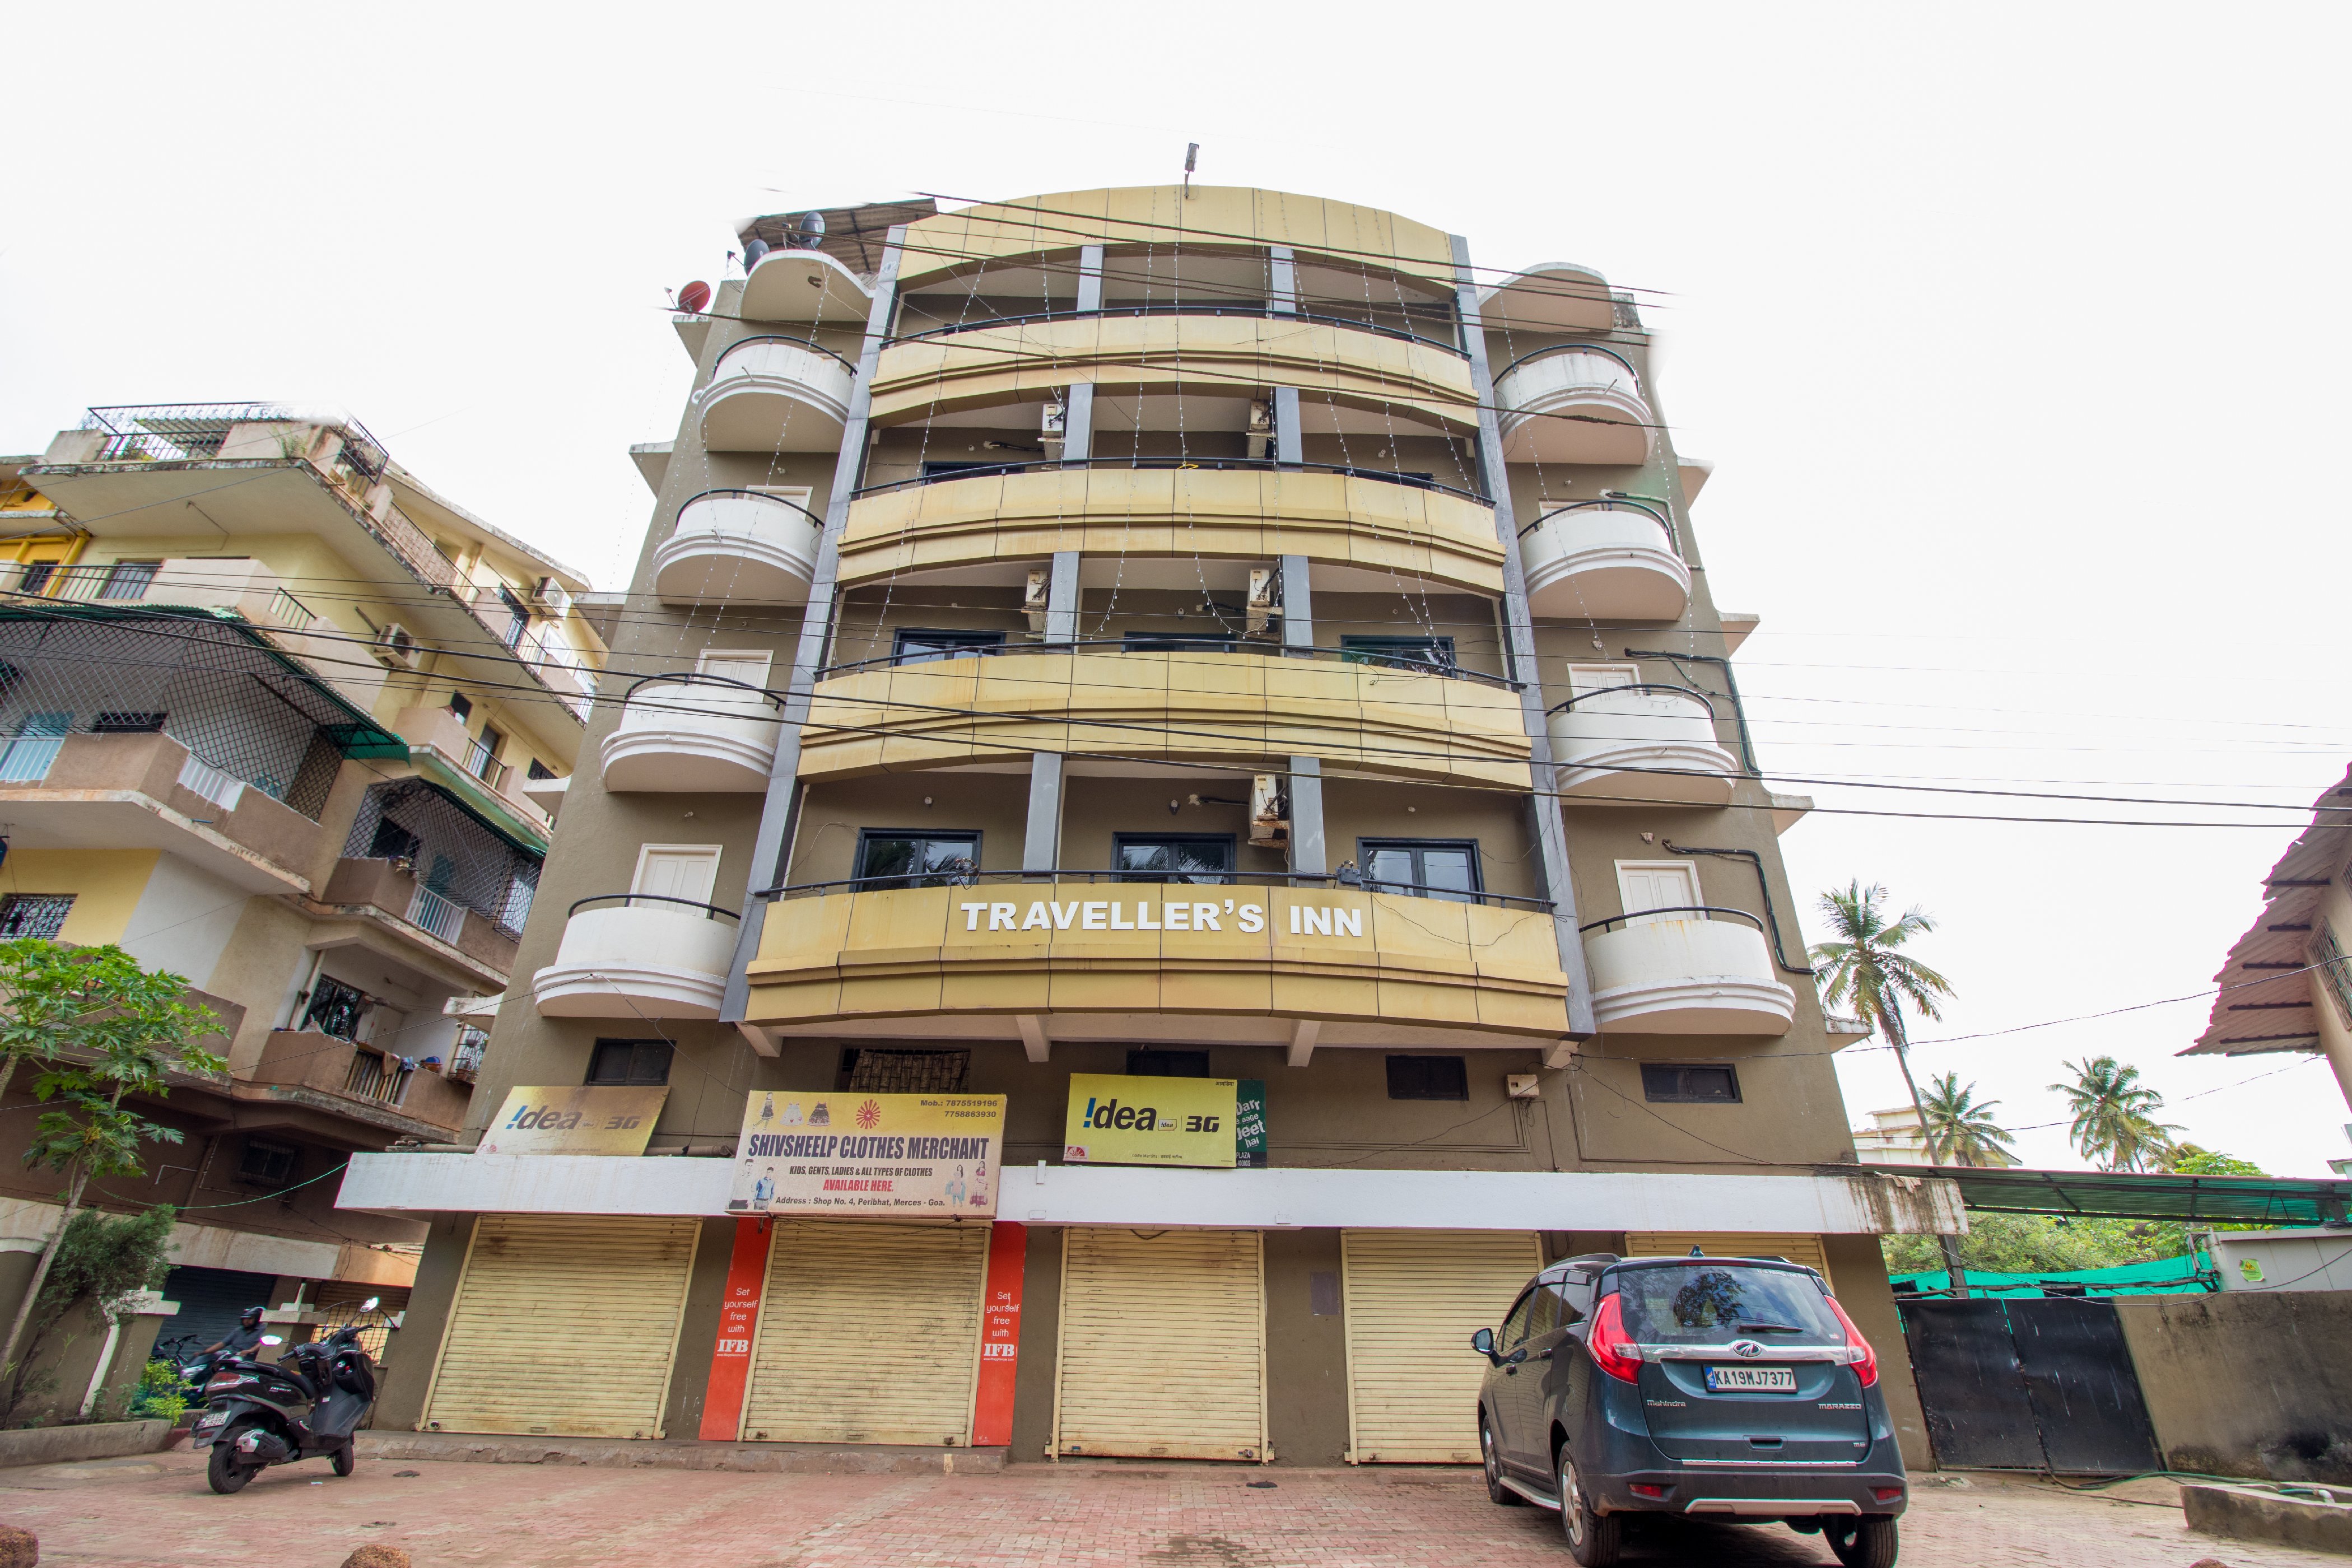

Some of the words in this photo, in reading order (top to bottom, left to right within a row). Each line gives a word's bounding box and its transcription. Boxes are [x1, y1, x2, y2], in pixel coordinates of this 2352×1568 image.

[961, 899, 1264, 934] TRAVELLER'S
[1289, 906, 1362, 937] INN
[604, 1116, 642, 1130] 3G
[1185, 1115, 1219, 1132] 3G
[748, 1134, 838, 1158] SHIVSHEELP
[840, 1135, 905, 1159] CLOTHES
[906, 1137, 989, 1160] MERCHANT
[1245, 1136, 1260, 1148] hai
[789, 1165, 807, 1175] KIDS,
[808, 1166, 830, 1176] GENTS,
[831, 1166, 854, 1175] LADIES
[861, 1167, 872, 1175] ALL
[874, 1167, 894, 1177] TYPES
[895, 1168, 903, 1177] OF
[903, 1168, 933, 1177] CLOTHES
[822, 1179, 869, 1191] AVAILABLE
[870, 1180, 894, 1192] HERE.
[813, 1197, 832, 1207] Shop
[849, 1198, 855, 1206] 4,
[858, 1198, 892, 1207] Peribhat,
[736, 1287, 750, 1296] Set
[998, 1291, 1010, 1300] Set
[724, 1300, 758, 1309] yourself
[986, 1304, 1019, 1314] yourself
[730, 1312, 747, 1320] free
[994, 1316, 1010, 1325] free
[728, 1324, 745, 1333] with
[992, 1329, 1009, 1337] with
[717, 1339, 749, 1352] IFB
[983, 1343, 1014, 1357] IFB
[1714, 1370, 1792, 1385] KA19MJ7377
